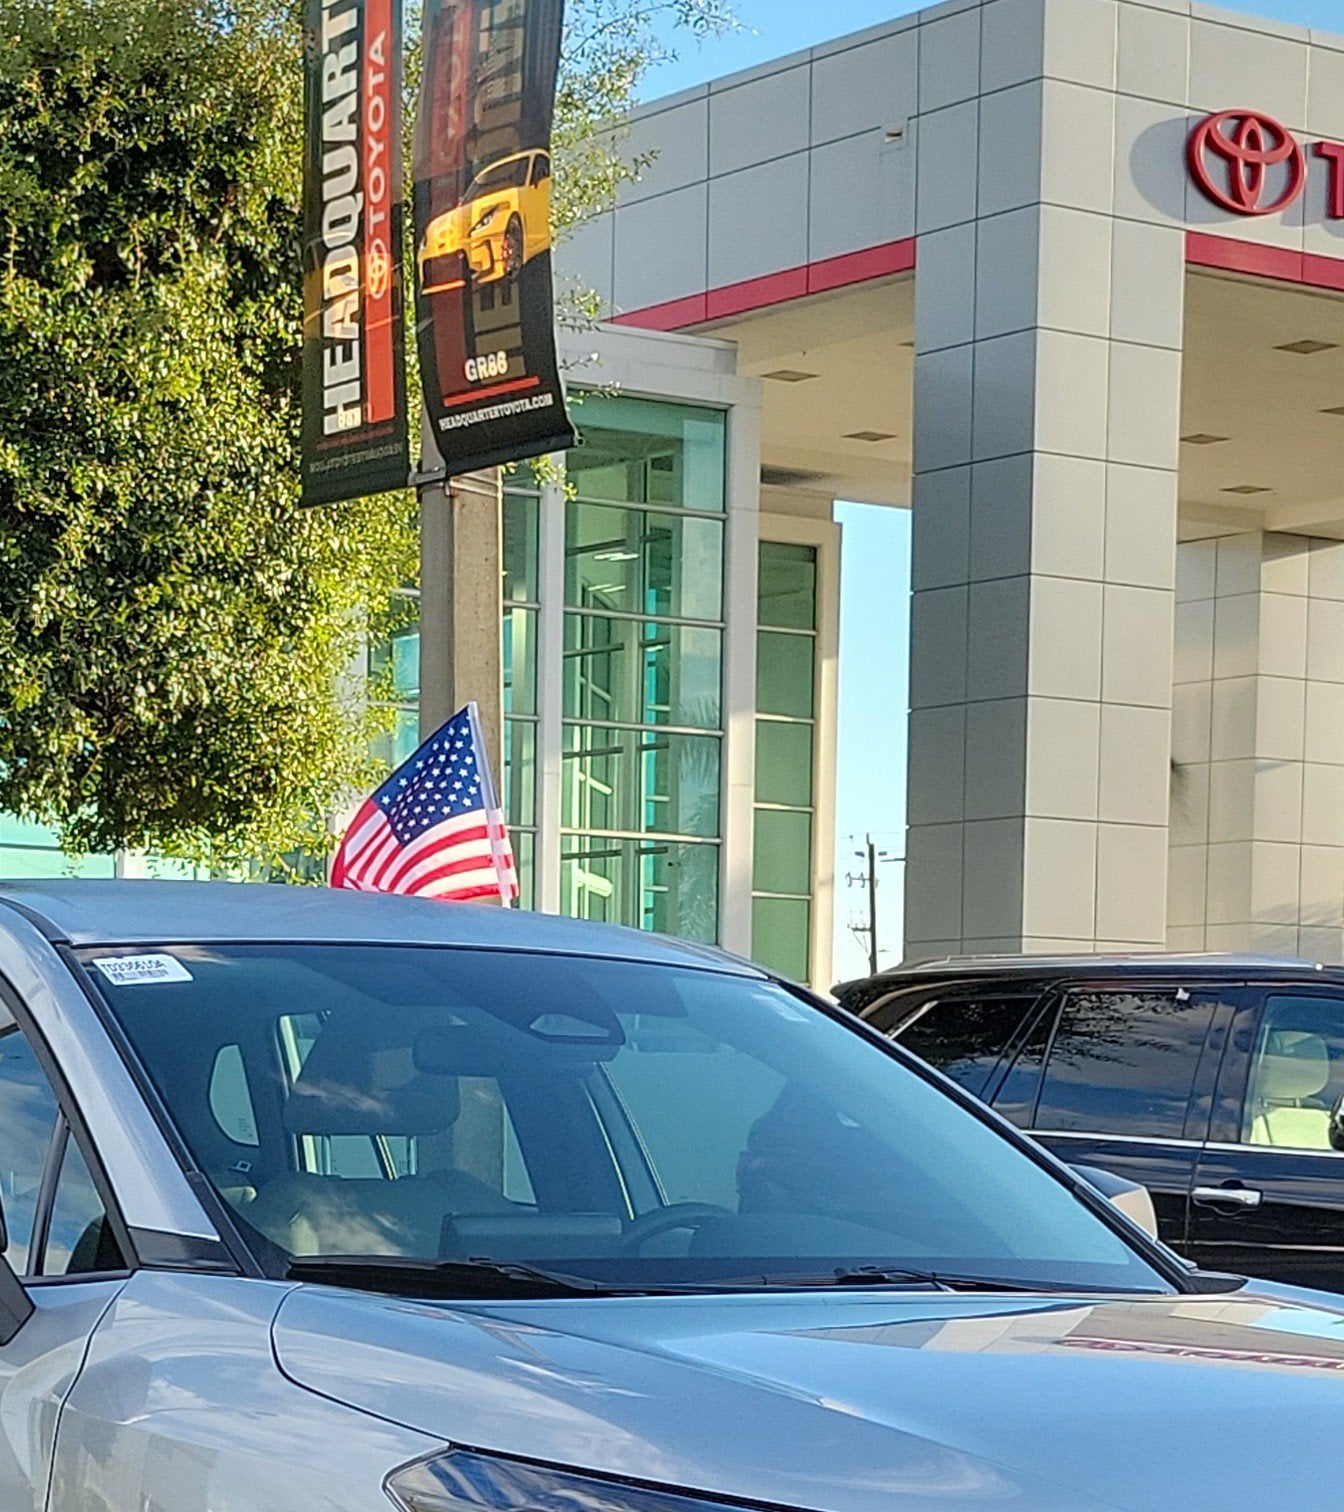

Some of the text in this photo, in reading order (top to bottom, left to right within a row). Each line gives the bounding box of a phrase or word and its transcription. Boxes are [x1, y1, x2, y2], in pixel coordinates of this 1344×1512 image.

[367, 31, 387, 230] TOYOTA
[322, 0, 362, 435] HEADQUART
[438, 392, 554, 431] HEADQUARTERTOYOTA.COM
[465, 350, 507, 382] GR86
